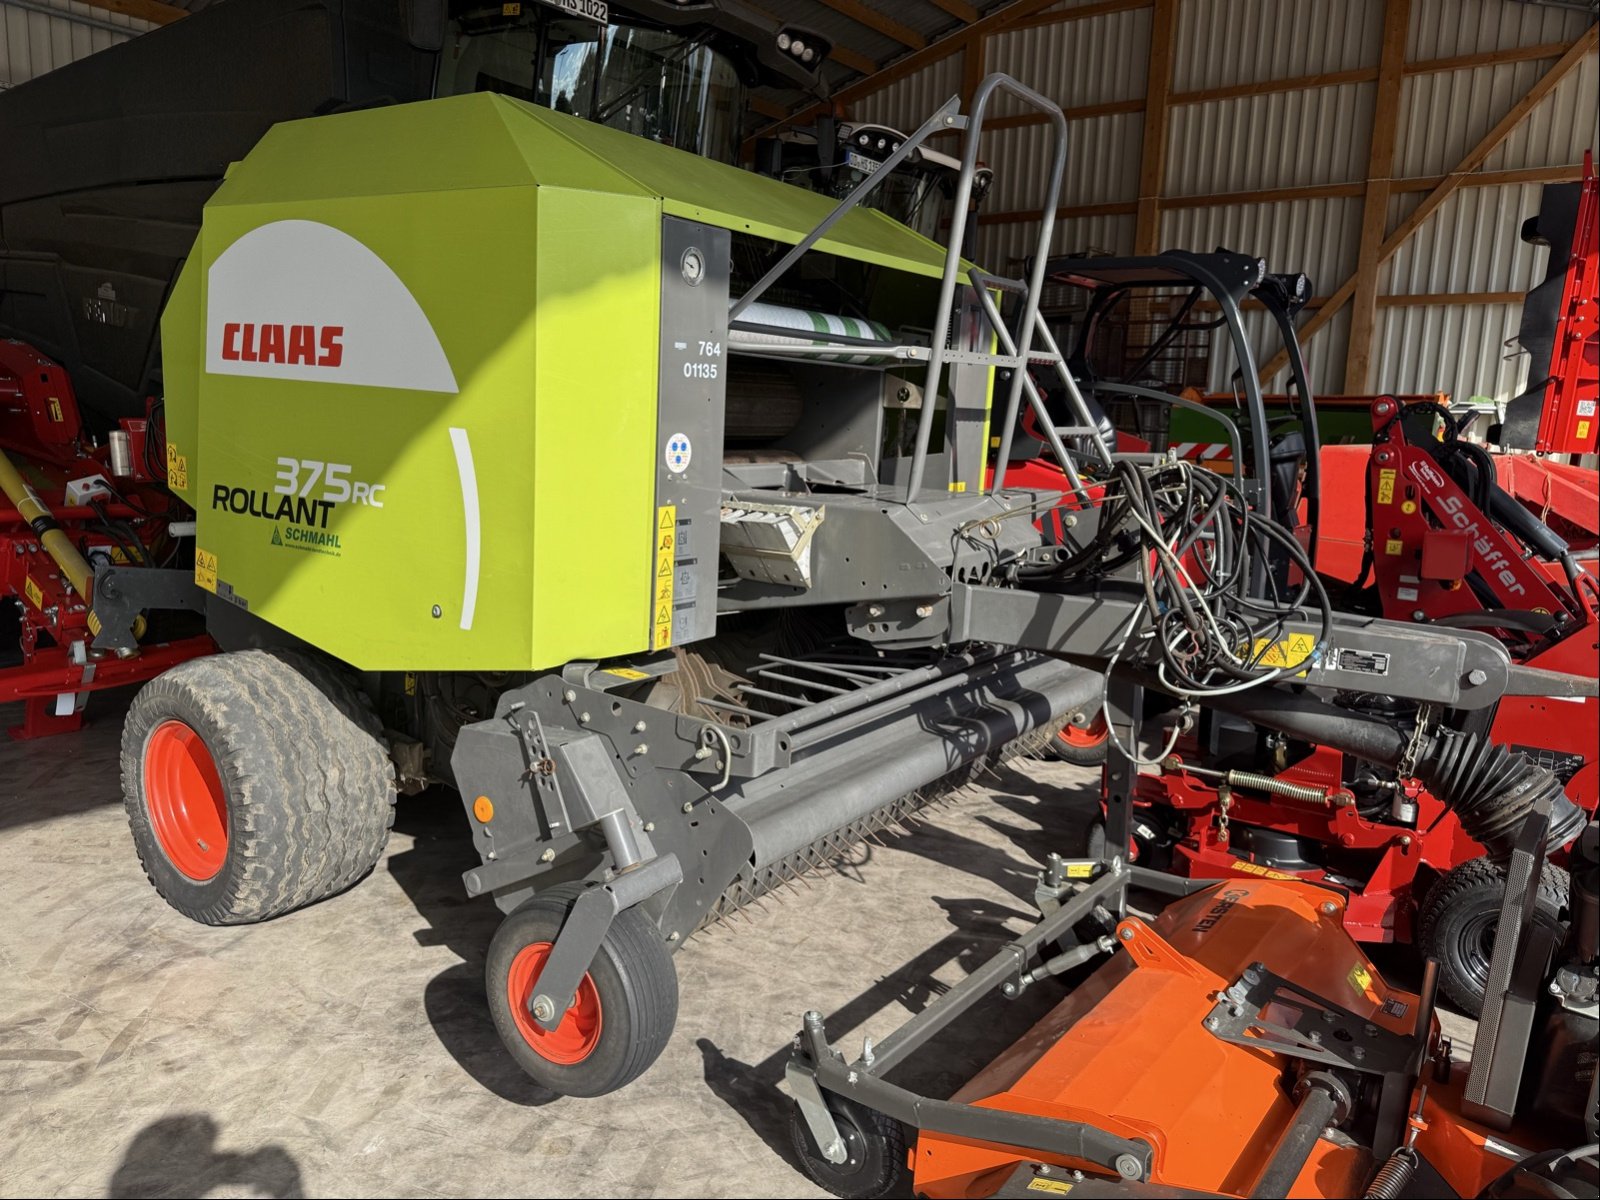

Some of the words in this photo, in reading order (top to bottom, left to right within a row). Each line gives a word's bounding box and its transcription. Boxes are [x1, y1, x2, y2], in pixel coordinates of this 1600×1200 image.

[580, 0, 606, 21] 1022
[222, 322, 344, 367] CLAAS
[698, 341, 721, 357] 764
[683, 362, 718, 379] 01135
[212, 484, 336, 529] ROLLANT
[285, 527, 342, 548] SCHMAHL
[1435, 495, 1526, 597] Schäffer
